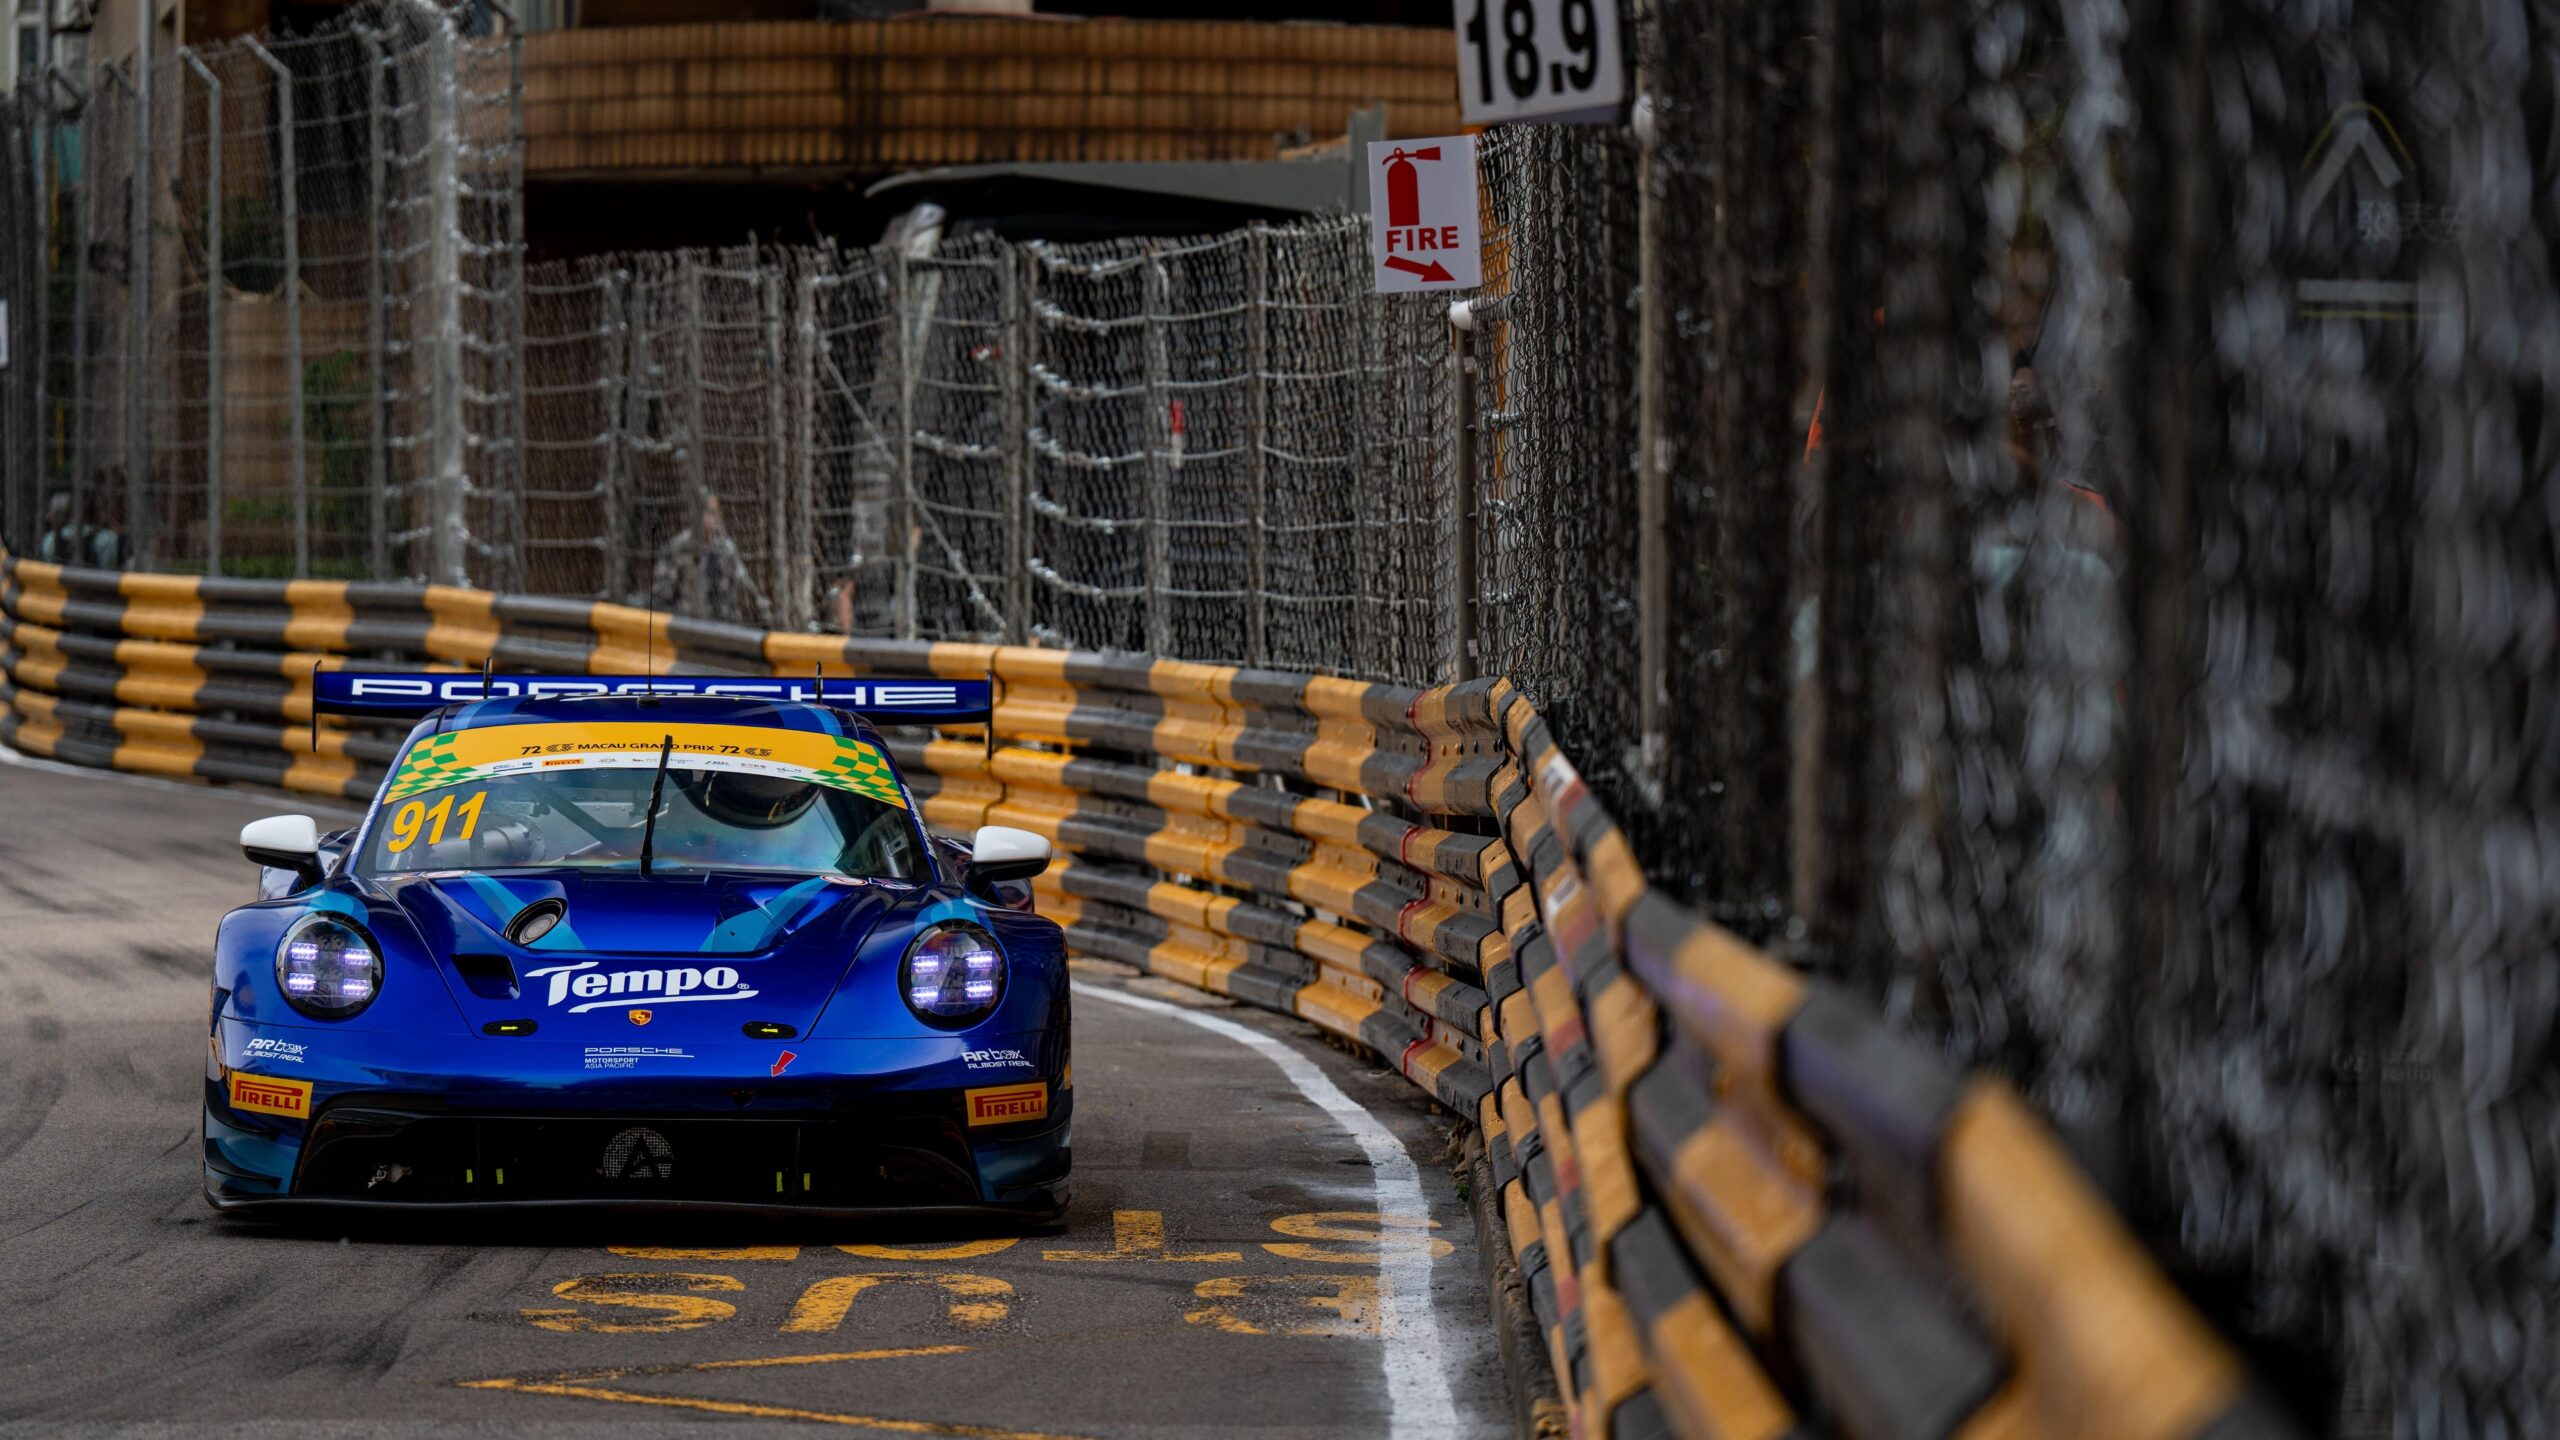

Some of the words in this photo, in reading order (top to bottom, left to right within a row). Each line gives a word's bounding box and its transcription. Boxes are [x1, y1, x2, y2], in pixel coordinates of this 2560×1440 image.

[1466, 0, 1599, 104] 18.9
[1386, 226, 1460, 253] FIRE
[351, 678, 957, 706] PORSCHE
[521, 745, 542, 756] 72
[720, 744, 740, 755] 72
[387, 790, 488, 854] 911
[524, 961, 740, 1007] Tempo
[242, 1050, 280, 1059] ALMOST
[279, 1053, 305, 1064] REAL
[584, 1047, 683, 1055] PORSCHE
[968, 1061, 1007, 1070] ALMOST
[1008, 1060, 1035, 1068] REAL
[233, 1080, 304, 1110] PIRELLI
[974, 1090, 1043, 1118] PIRELLI
